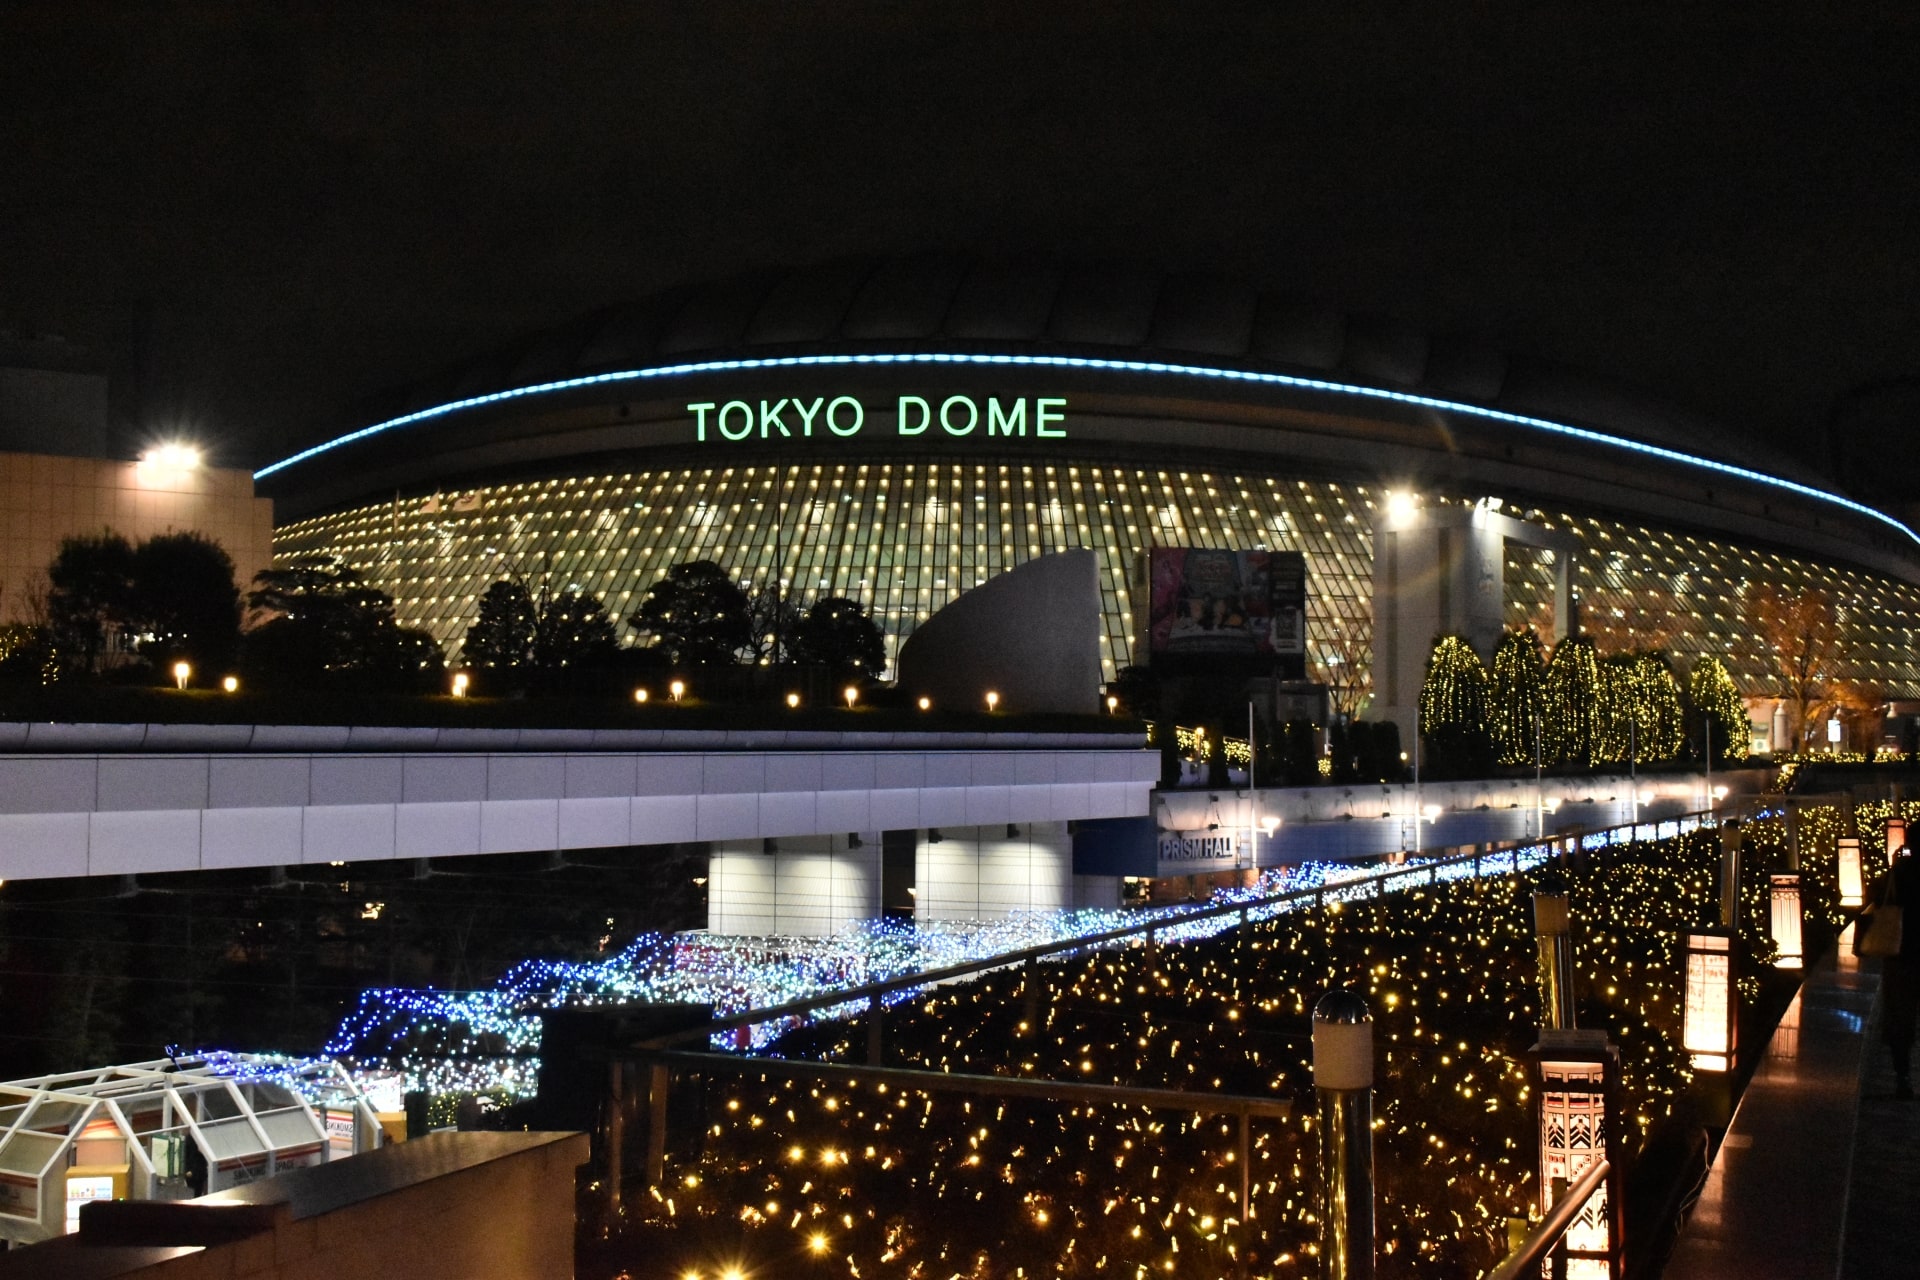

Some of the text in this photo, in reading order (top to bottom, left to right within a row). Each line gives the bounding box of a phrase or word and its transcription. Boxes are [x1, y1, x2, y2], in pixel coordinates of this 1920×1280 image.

[687, 395, 1067, 441] TOKYO DOME
[1162, 839, 1203, 860] PRISM
